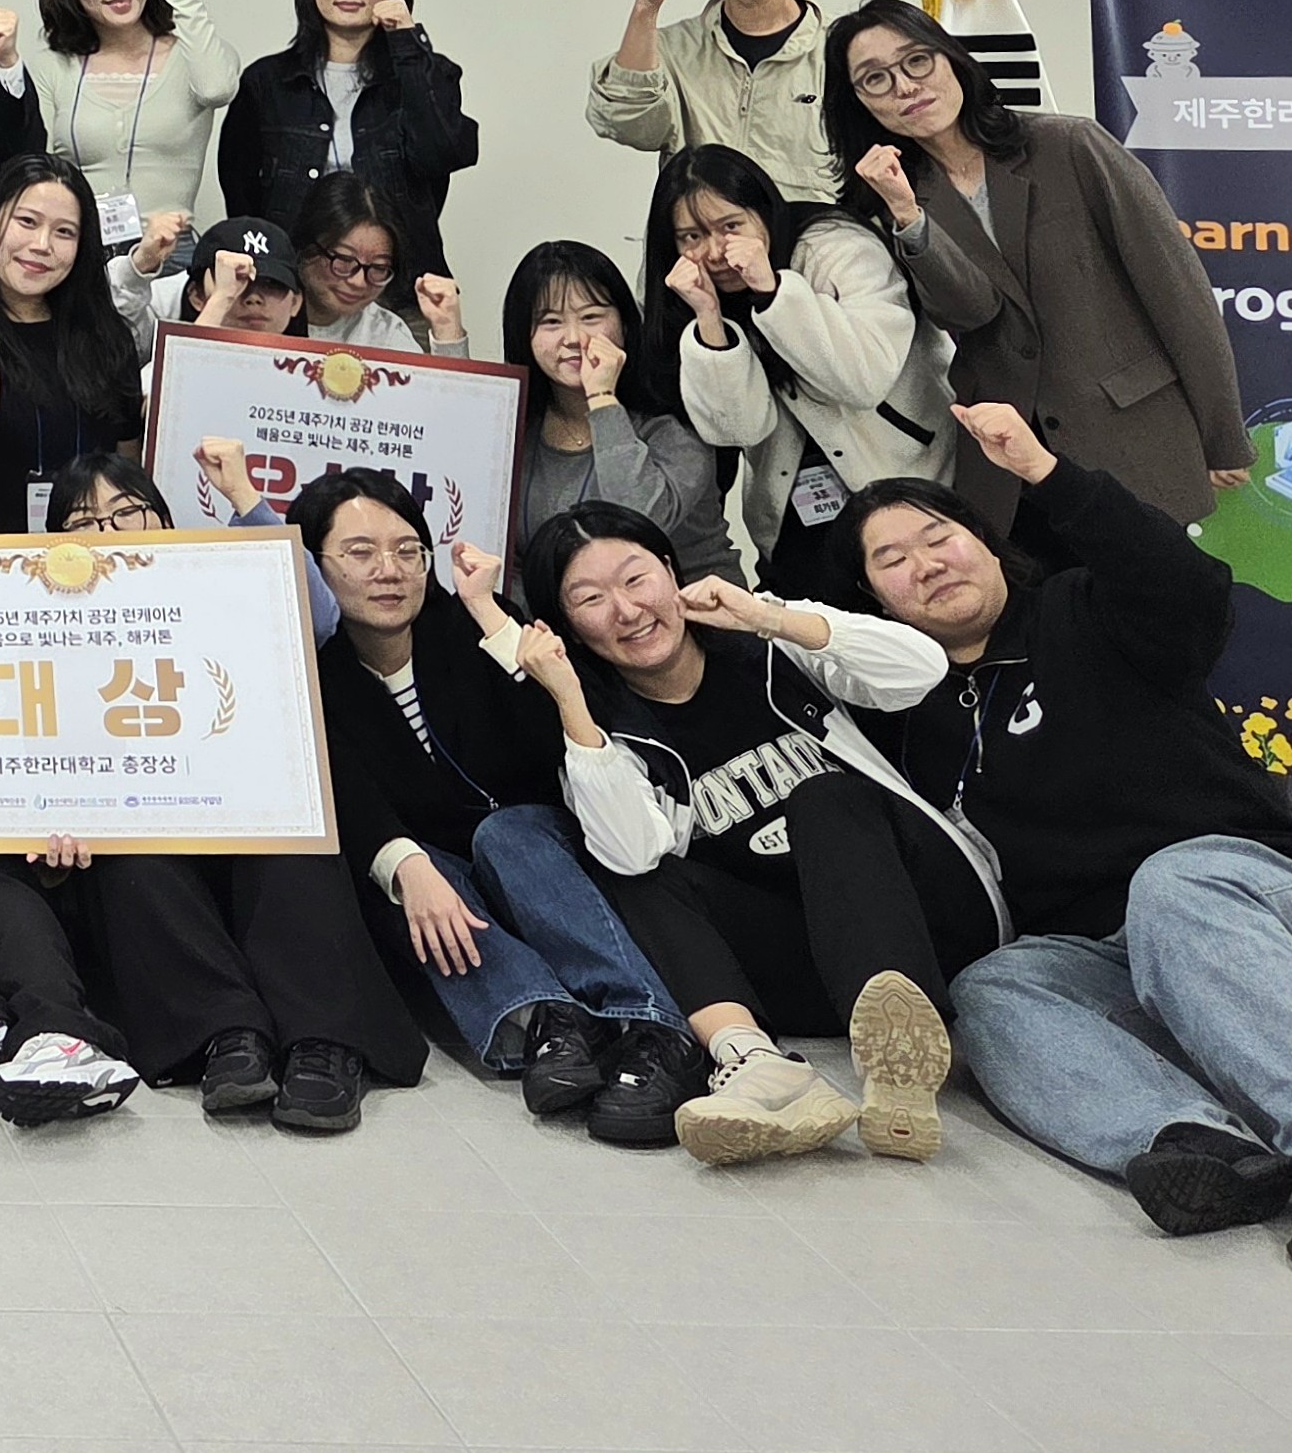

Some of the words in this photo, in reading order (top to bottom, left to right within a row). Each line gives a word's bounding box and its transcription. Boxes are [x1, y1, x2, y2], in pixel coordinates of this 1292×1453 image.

[249, 406, 295, 424] 2025년
[298, 412, 346, 430] 제주가치
[350, 418, 373, 433] 공감
[378, 422, 424, 440] 런케이션
[257, 427, 303, 444] 배움으로
[308, 433, 342, 450] 빛나는
[346, 438, 373, 455] 제주,
[378, 442, 412, 458] 해커톤
[25, 610, 82, 625] 제주가치
[88, 609, 116, 625] 공감
[122, 607, 181, 623] 런케이션
[39, 632, 82, 647] 빛나는
[87, 631, 122, 647] 제주,
[127, 629, 172, 645] 해커톤
[122, 755, 176, 774] 총장상
